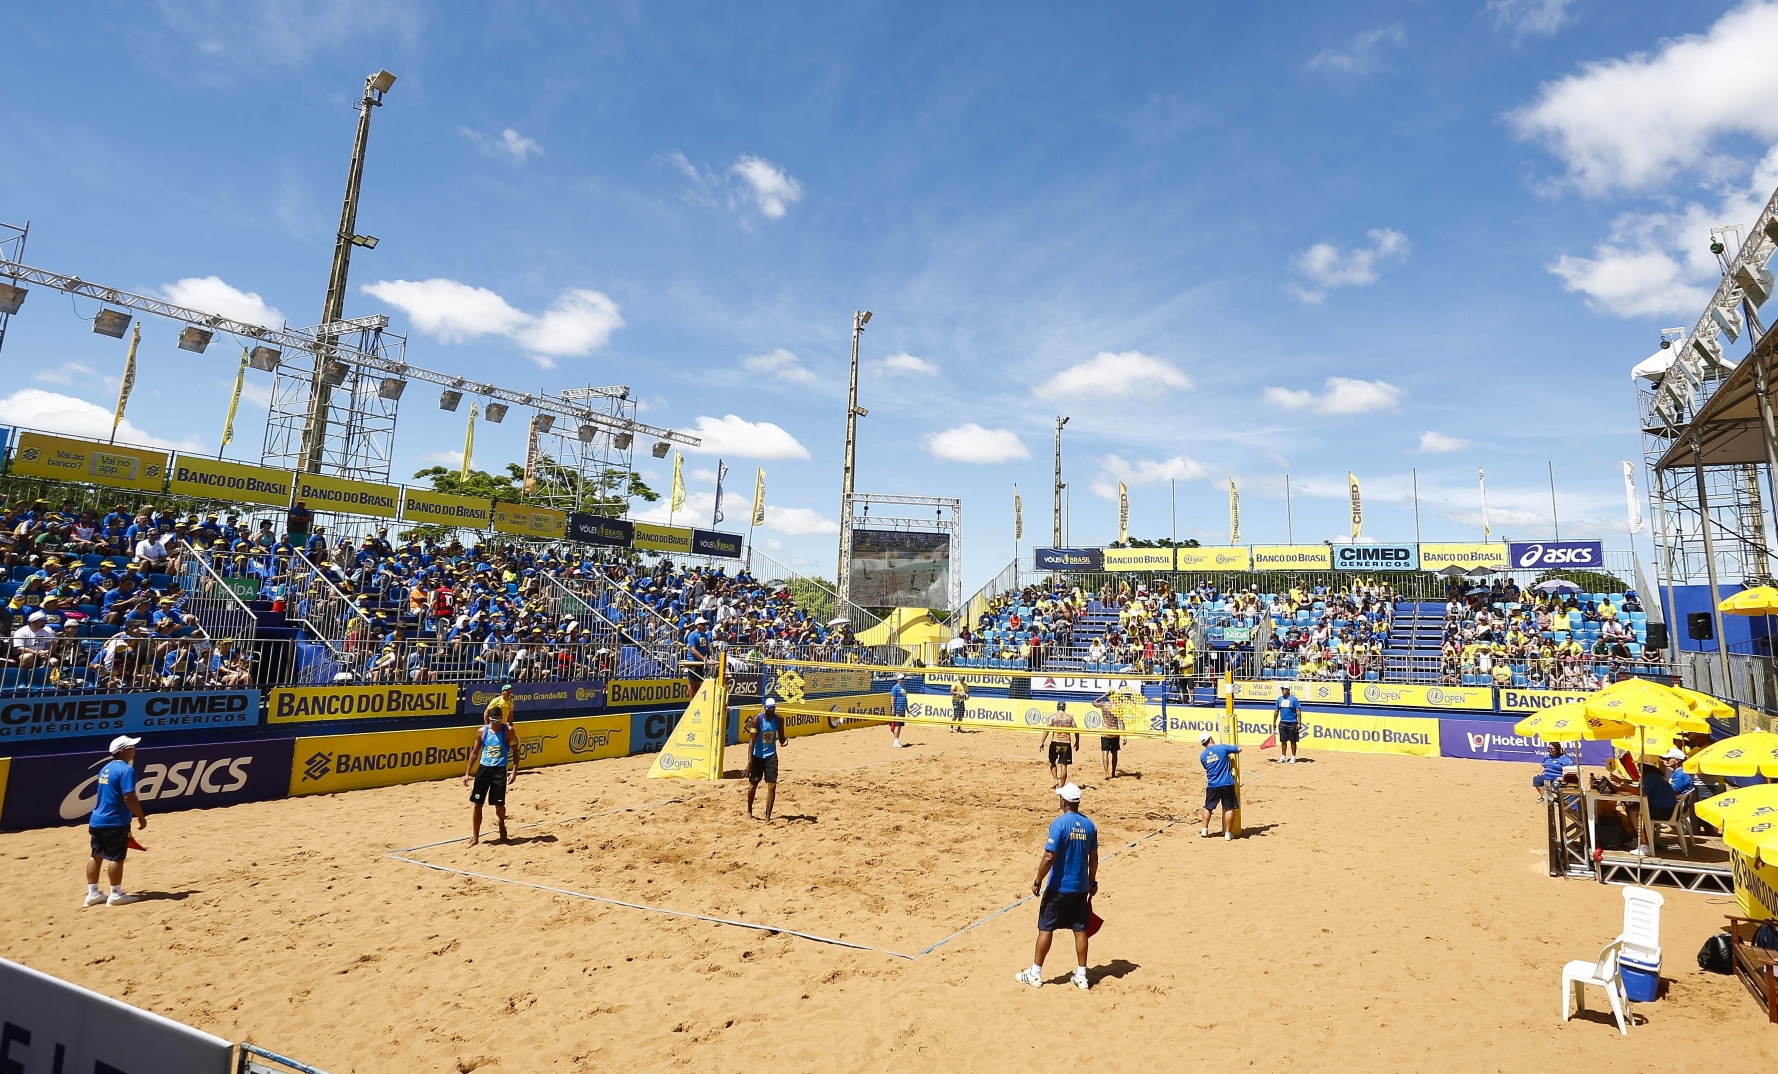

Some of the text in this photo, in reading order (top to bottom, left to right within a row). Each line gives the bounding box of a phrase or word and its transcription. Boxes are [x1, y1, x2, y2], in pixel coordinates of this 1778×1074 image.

[57, 450, 71, 459] Vai
[101, 456, 116, 465] Vai
[47, 458, 84, 470] banco?
[99, 464, 119, 475] app.
[177, 468, 287, 496] BANCO DO BRASIL
[302, 486, 394, 508] BANCO DO BRASIL
[407, 499, 487, 520] BANCO DO BRASIL
[1352, 484, 1362, 524] CIMED
[604, 529, 624, 538] BRASIL
[636, 531, 659, 542] BANCO
[669, 535, 689, 545] BRASIL
[1107, 556, 1132, 564] BANCO
[1256, 554, 1285, 562] BANCO
[1299, 554, 1328, 562] BRASIL
[1340, 548, 1410, 561] CIMED
[1424, 552, 1455, 561] BANCO
[1471, 552, 1503, 561] BRASIL
[219, 583, 253, 596] SAÍDA
[445, 595, 453, 606] 10
[1226, 630, 1247, 638] SAÍDA
[509, 693, 531, 702] Campo
[612, 684, 653, 702] BANCO
[656, 686, 670, 699] DO
[701, 690, 707, 701] 1
[145, 694, 248, 716] CIMED
[277, 690, 449, 717] BANCO DO BRASIL
[1506, 692, 1563, 708] BANCO
[2, 699, 127, 725] CIMED
[925, 705, 954, 717] BANC
[978, 708, 1013, 721] BRASIL
[144, 713, 246, 727] GENÉRICOS
[786, 714, 820, 727] DO BRASIL
[1170, 718, 1213, 731] BANCO
[0, 719, 124, 736] GENÉRICOS
[1314, 725, 1431, 744] BANCO DO BRASIL
[1492, 735, 1529, 747] Hotel
[588, 736, 608, 747] OPEN
[520, 742, 543, 756] OPEN
[336, 747, 474, 774] BANCO DO BRASI
[1609, 761, 1613, 770] 1
